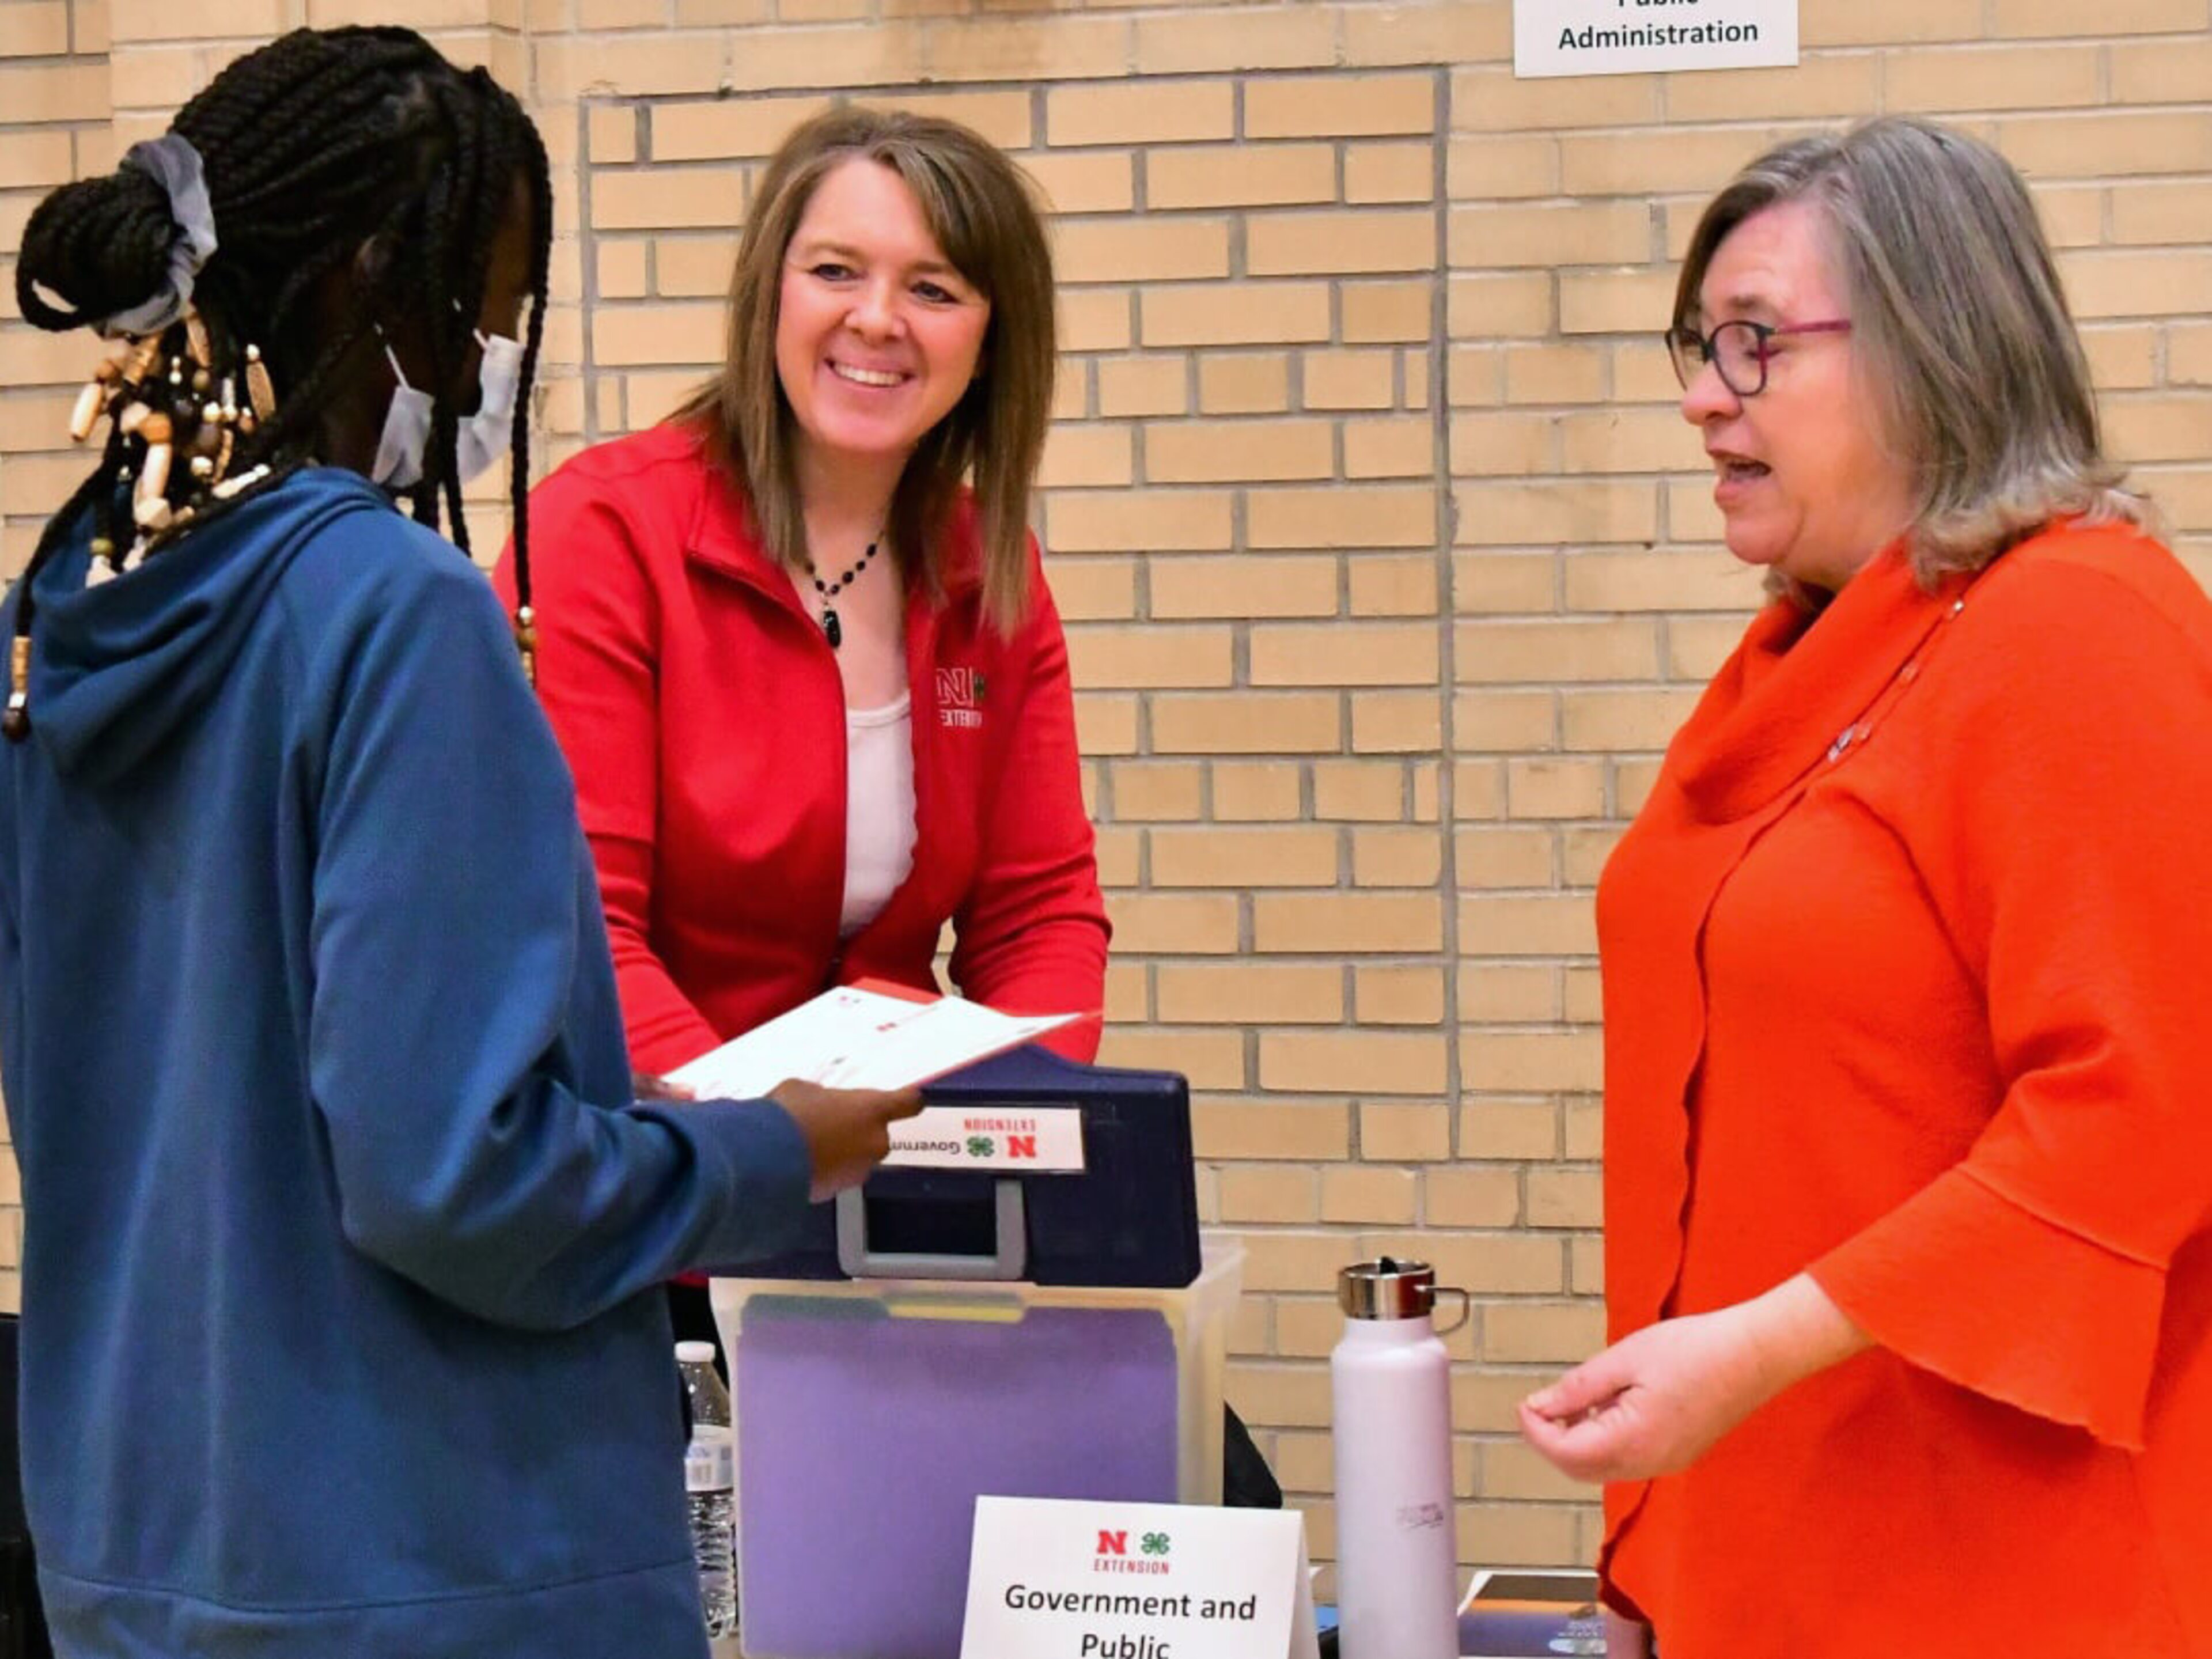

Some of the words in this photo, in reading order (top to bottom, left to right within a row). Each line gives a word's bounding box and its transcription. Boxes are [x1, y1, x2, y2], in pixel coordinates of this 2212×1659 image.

[1559, 21, 1758, 50] Administration
[964, 1119, 1036, 1132] EXTENSION
[1007, 1135, 1036, 1158] N
[1097, 1530, 1128, 1555] N
[1094, 1558, 1169, 1575] EXTENSION
[1005, 1584, 1191, 1617] Government
[1201, 1594, 1256, 1620] and
[1081, 1633, 1170, 1659] Public
